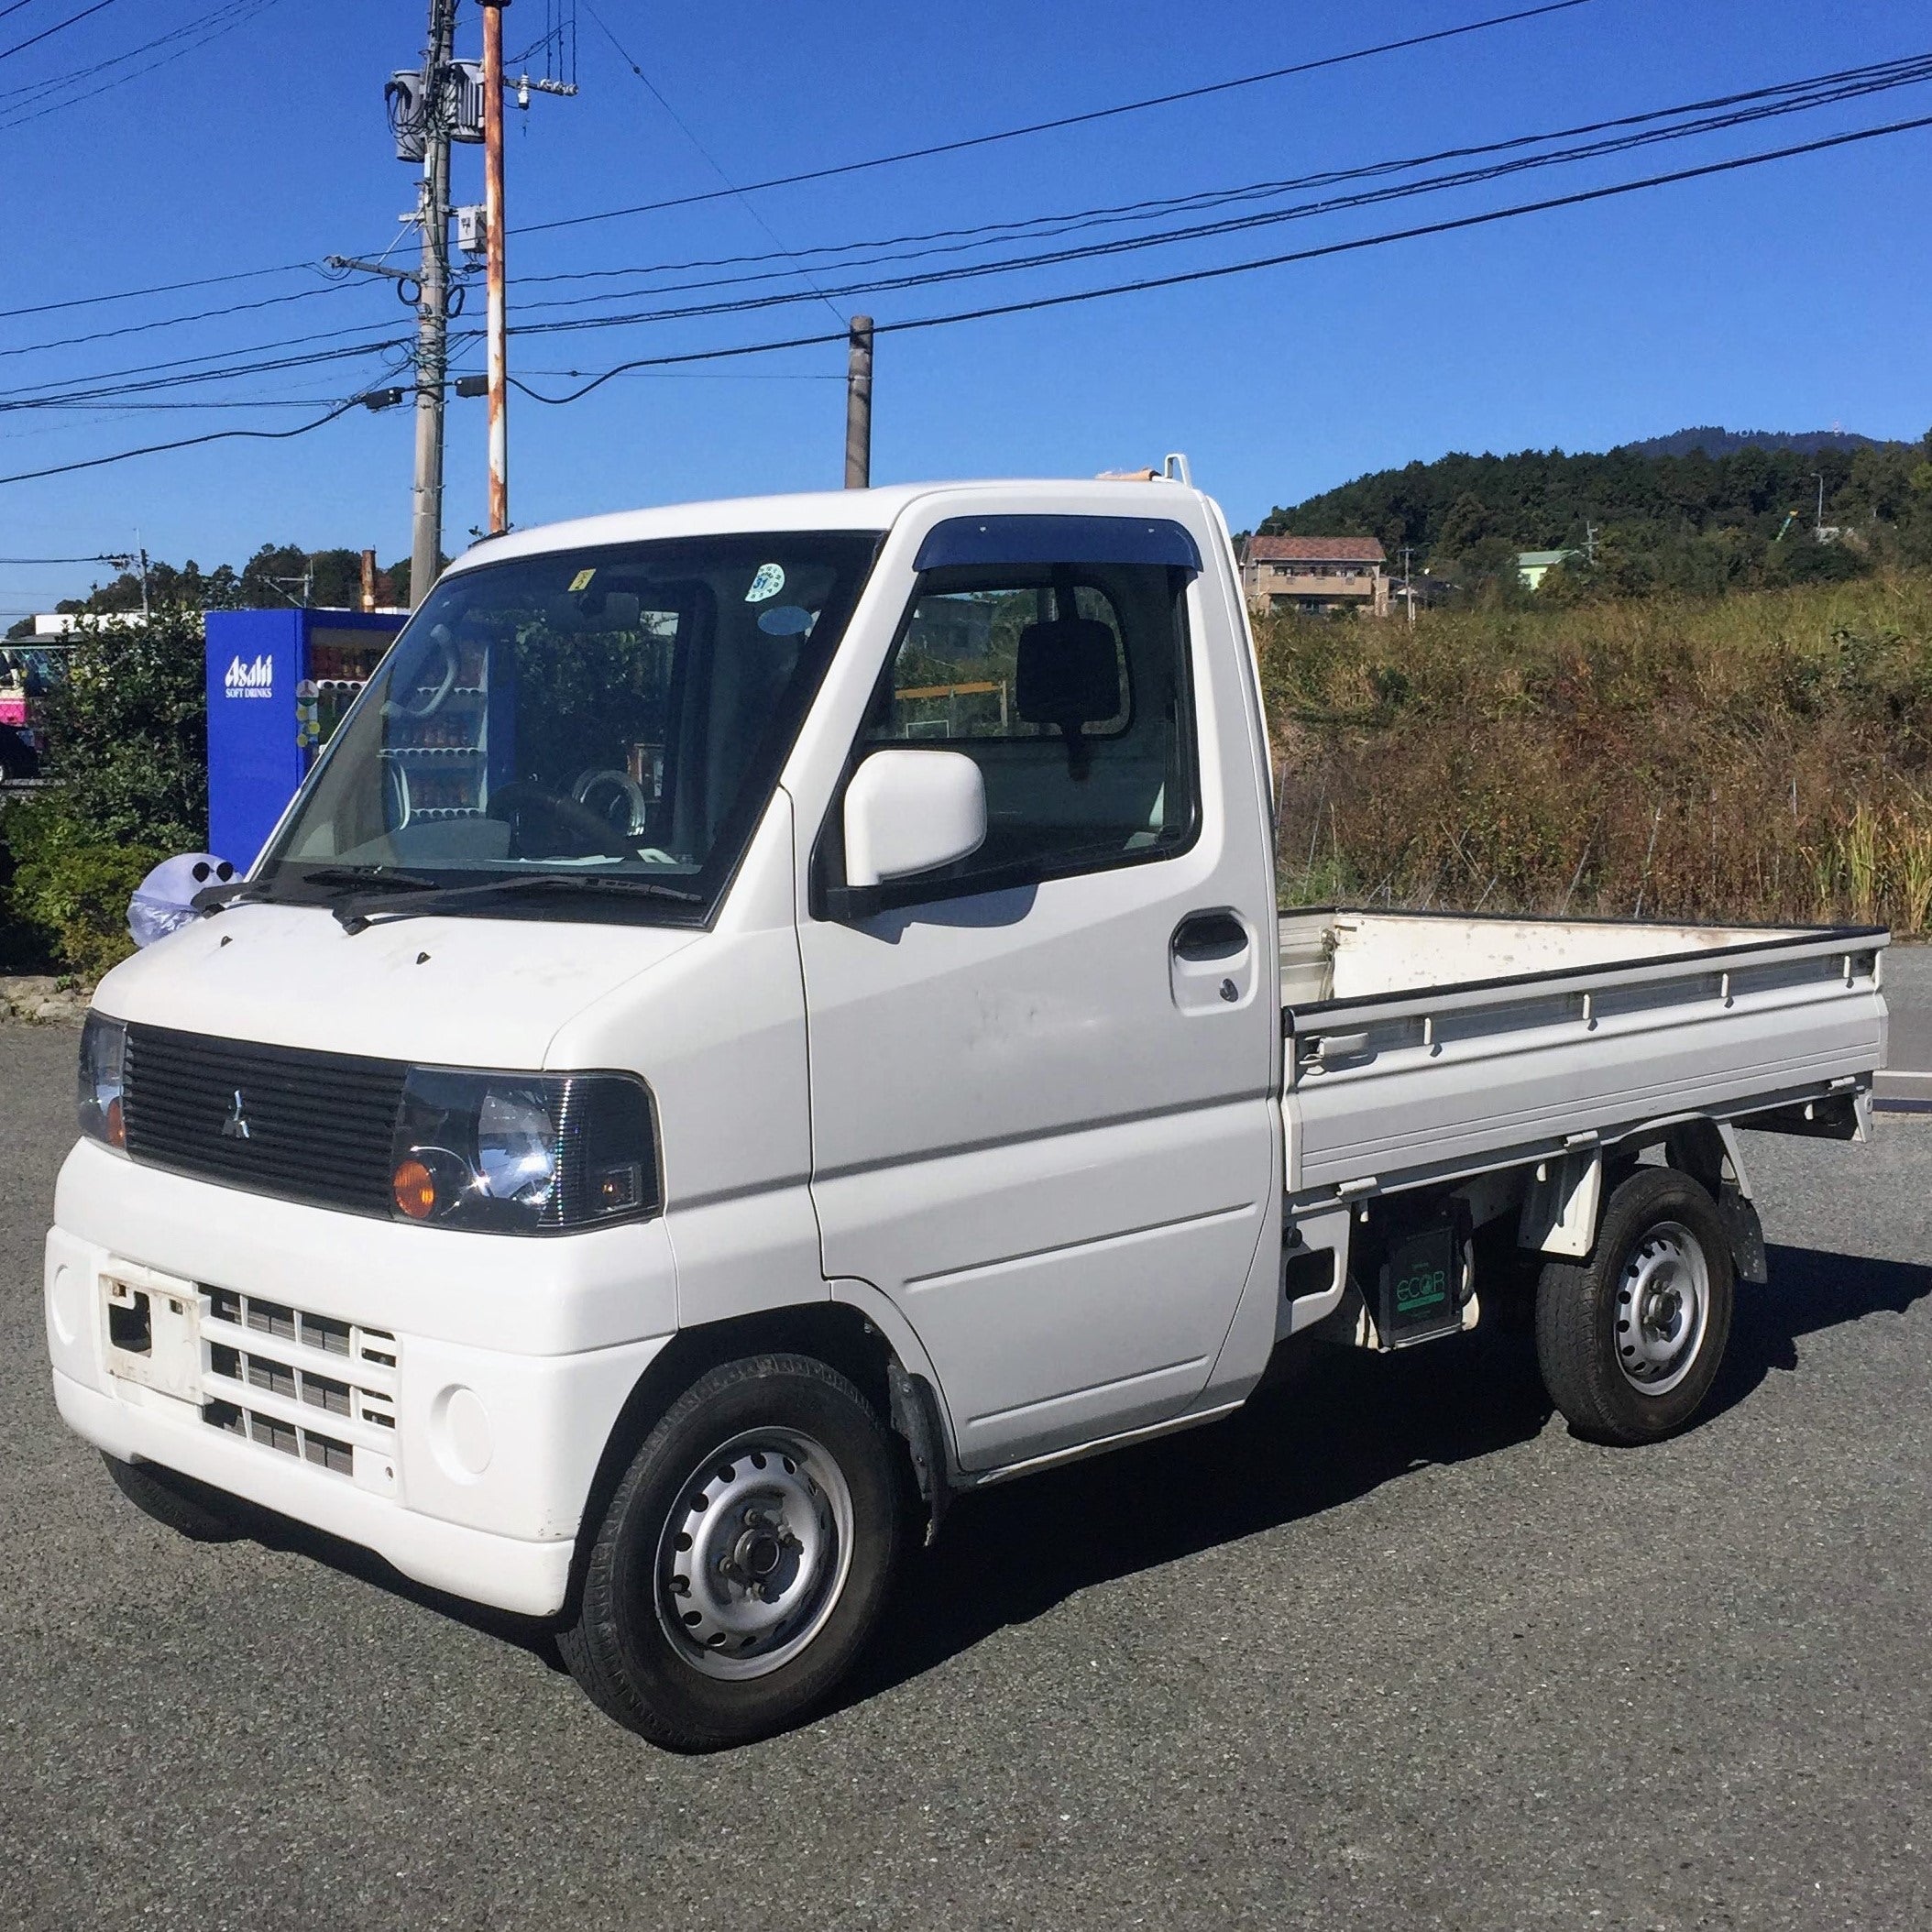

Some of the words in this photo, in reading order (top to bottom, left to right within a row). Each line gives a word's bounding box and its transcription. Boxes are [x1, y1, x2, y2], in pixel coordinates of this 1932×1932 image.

[225, 654, 272, 687] Asahi
[225, 687, 244, 698] SOFT
[245, 687, 272, 698] DRINKS
